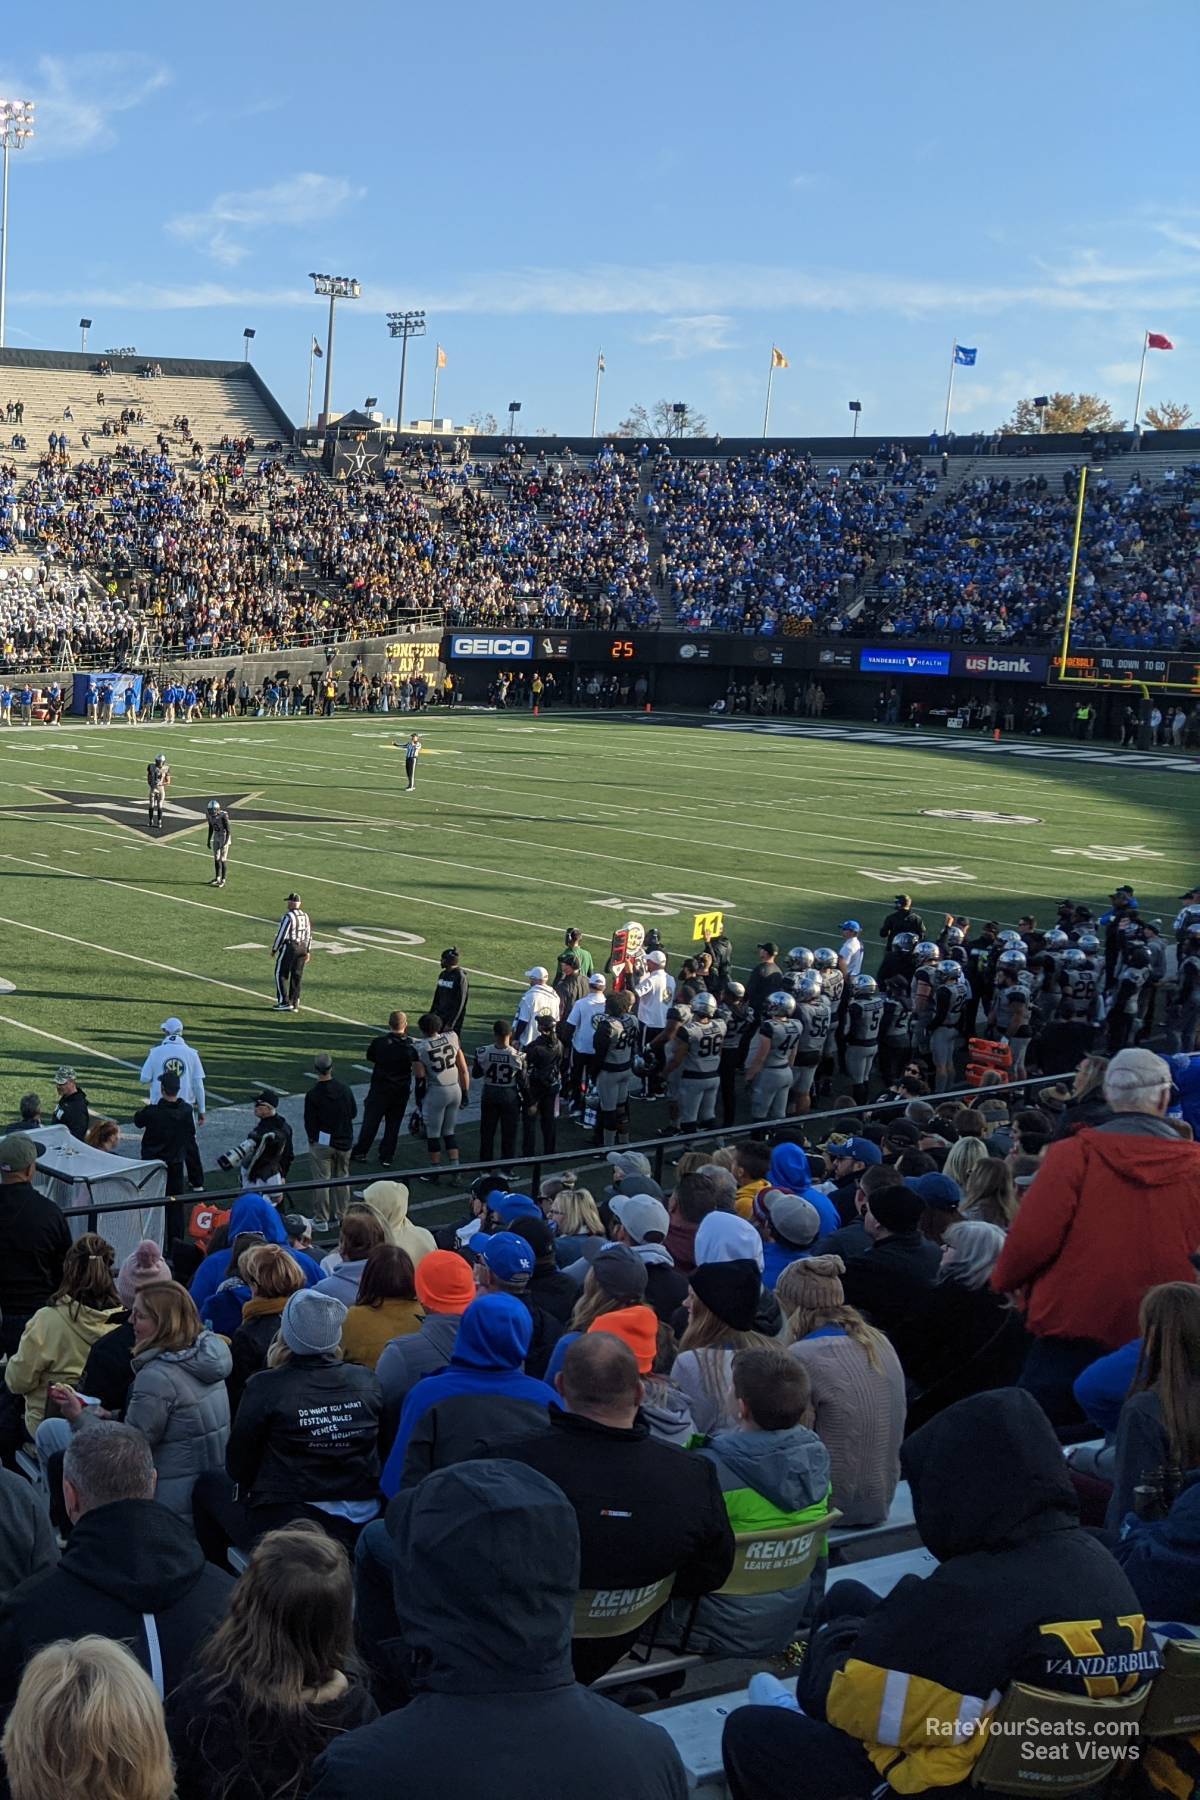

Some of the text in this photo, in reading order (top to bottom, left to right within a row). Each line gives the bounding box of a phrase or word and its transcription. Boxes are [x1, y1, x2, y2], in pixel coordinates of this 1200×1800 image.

[454, 638, 530, 655] GEICO
[612, 641, 633, 657] 25
[868, 657, 906, 665] VANDERBILT
[1118, 659, 1140, 670] DOWN
[1144, 660, 1166, 671] TO GO
[583, 892, 737, 916] 50
[697, 915, 719, 936] 11
[810, 1016, 829, 1037] 56
[870, 1009, 880, 1031] 5
[698, 1035, 724, 1058] 96
[428, 1045, 455, 1073] 52
[486, 1062, 513, 1084] 43
[309, 1406, 328, 1415] WHAT
[330, 1404, 342, 1412] YOU
[343, 1401, 362, 1409] WANT
[299, 1414, 353, 1427] FESTIVAL RULES
[311, 1424, 340, 1437] VENICE
[744, 1560, 772, 1571] LEAVE
[773, 1559, 783, 1569] IN
[588, 1607, 617, 1618] LEAVE
[618, 1606, 630, 1617] IN
[1045, 1650, 1162, 1676] VANDERBILT
